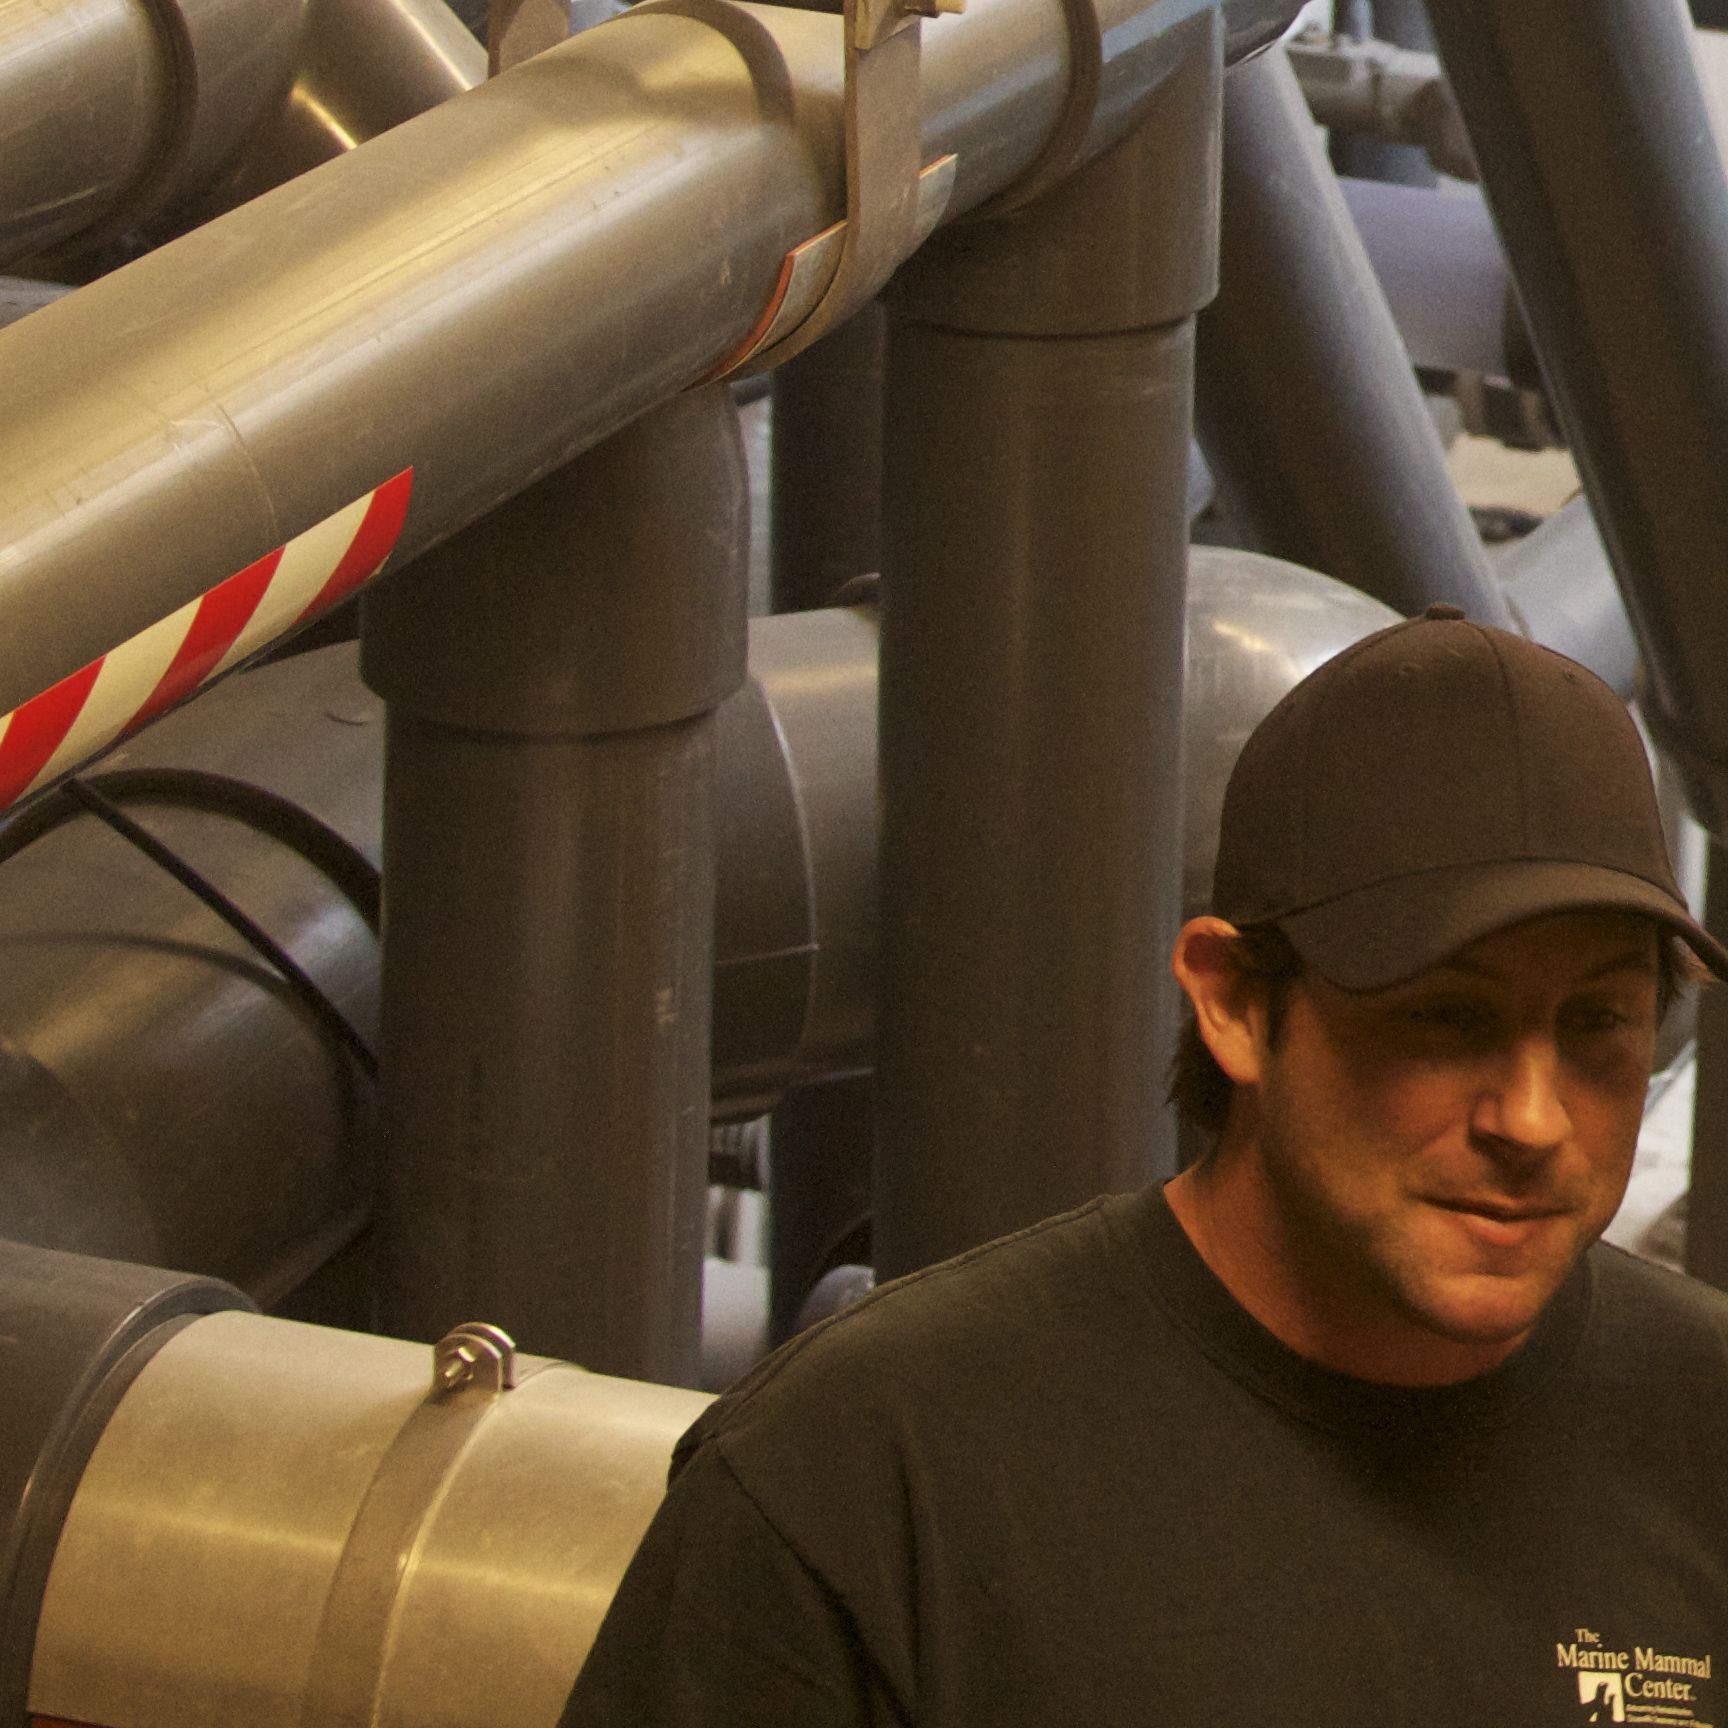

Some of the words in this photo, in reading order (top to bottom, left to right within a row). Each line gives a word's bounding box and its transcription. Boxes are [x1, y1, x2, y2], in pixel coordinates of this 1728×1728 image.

[1574, 1628, 1600, 1643] The
[1556, 1643, 1629, 1669] Marine
[1634, 1646, 1711, 1679] Mammal
